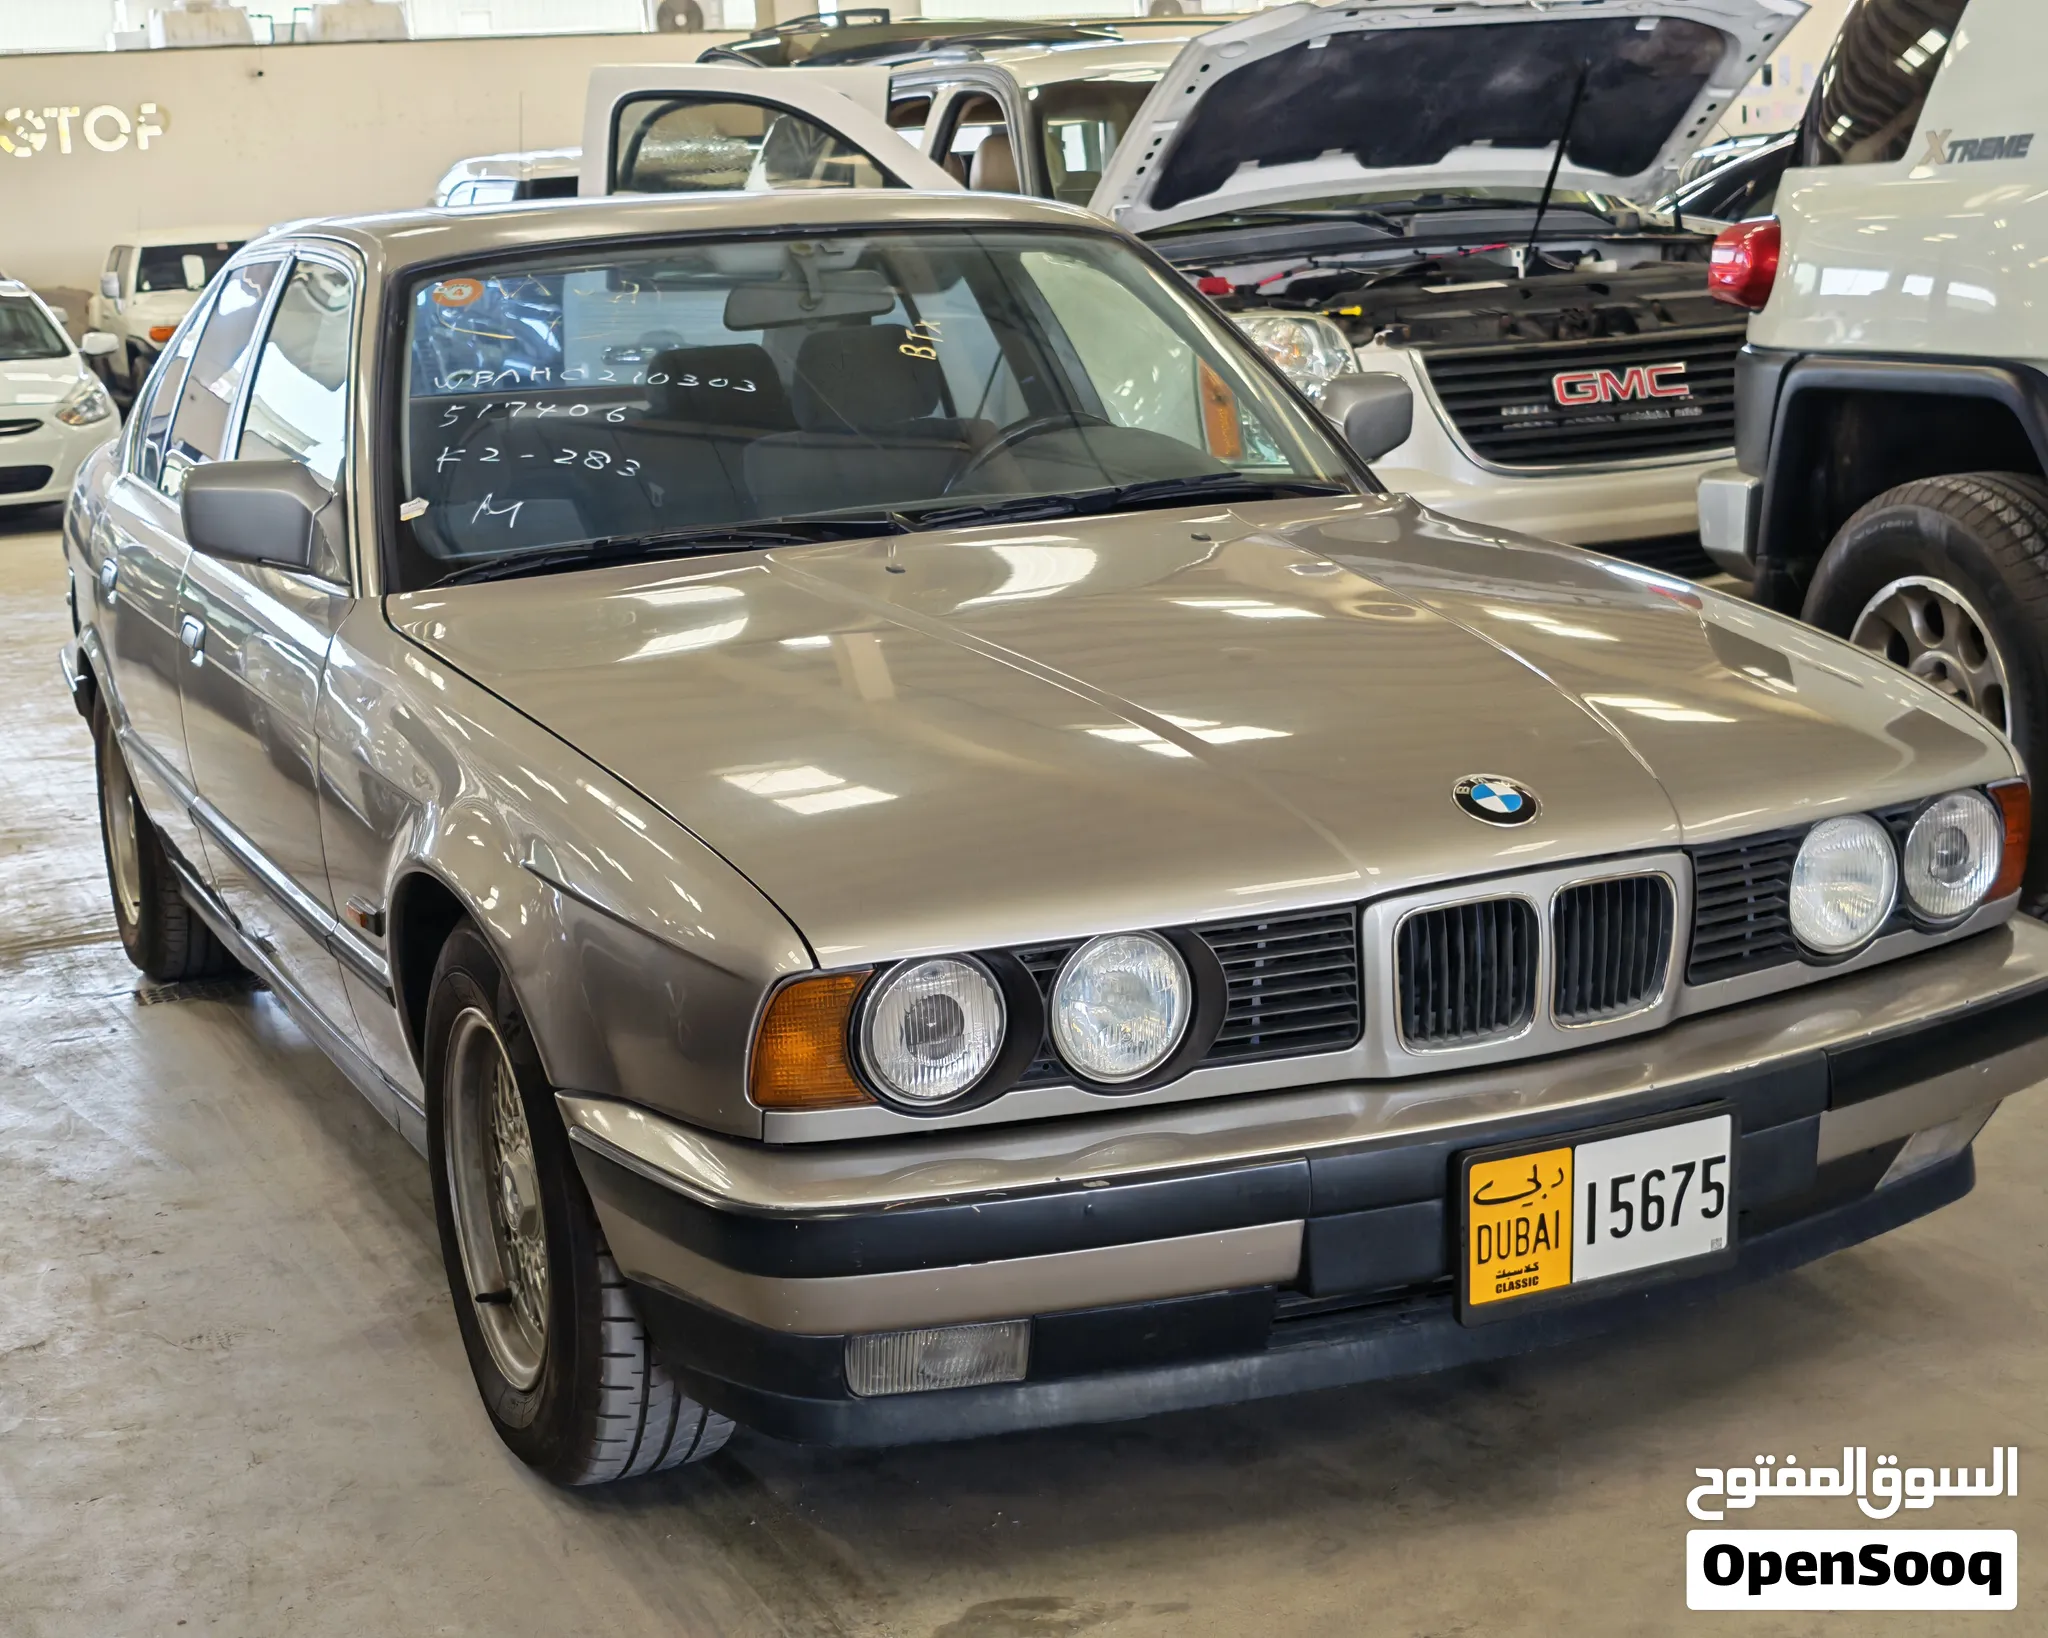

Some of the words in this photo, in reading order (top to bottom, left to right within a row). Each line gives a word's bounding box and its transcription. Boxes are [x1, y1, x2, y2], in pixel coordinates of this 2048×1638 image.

[0, 102, 168, 158] STOP
[1918, 128, 2034, 165] XTREME
[1553, 361, 1690, 406] GMC
[1473, 1163, 1565, 1208] دبي
[1586, 1154, 1727, 1246] 15675
[1477, 1209, 1560, 1265] DUBAI
[1495, 1275, 1540, 1295] CLASSIC
